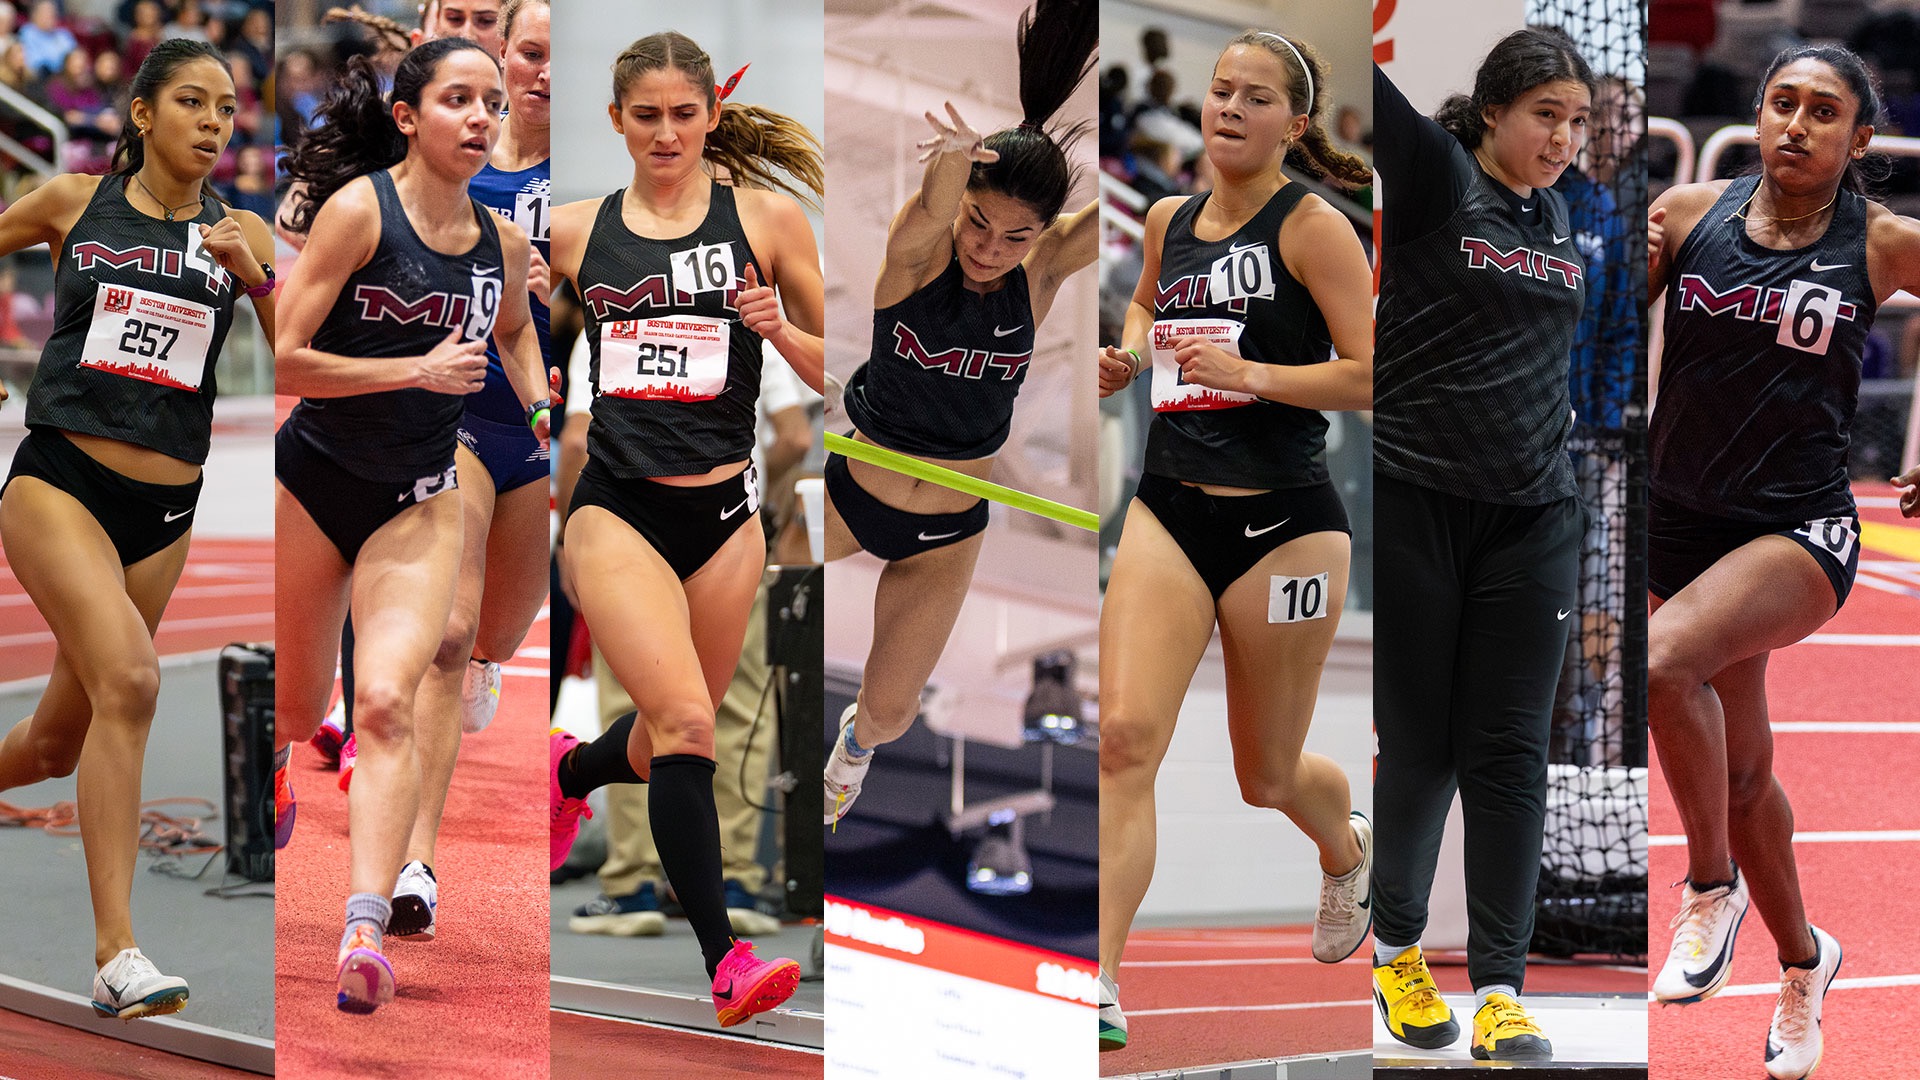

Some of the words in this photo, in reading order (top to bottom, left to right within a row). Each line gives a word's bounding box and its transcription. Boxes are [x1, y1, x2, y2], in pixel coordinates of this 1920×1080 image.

[683, 248, 727, 290] 16
[1220, 250, 1262, 297] 10
[1460, 236, 1583, 290] MIT
[104, 288, 134, 311] BU
[140, 297, 166, 310] BOSTON
[167, 303, 207, 320] UNIVERSITY
[354, 284, 475, 329] MI
[476, 281, 496, 337] 9
[1154, 275, 1276, 314] MI
[1679, 273, 1857, 324] MI
[118, 318, 179, 361] 257
[647, 320, 674, 329] BOSTON
[676, 322, 719, 333] UNIVERSITY
[1176, 326, 1196, 335] BOSTON
[1196, 326, 1232, 335] UNIVERSITY
[1792, 288, 1829, 348] 6
[637, 342, 688, 378] 251
[893, 321, 1033, 381] MIT
[1281, 577, 1321, 620] 10
